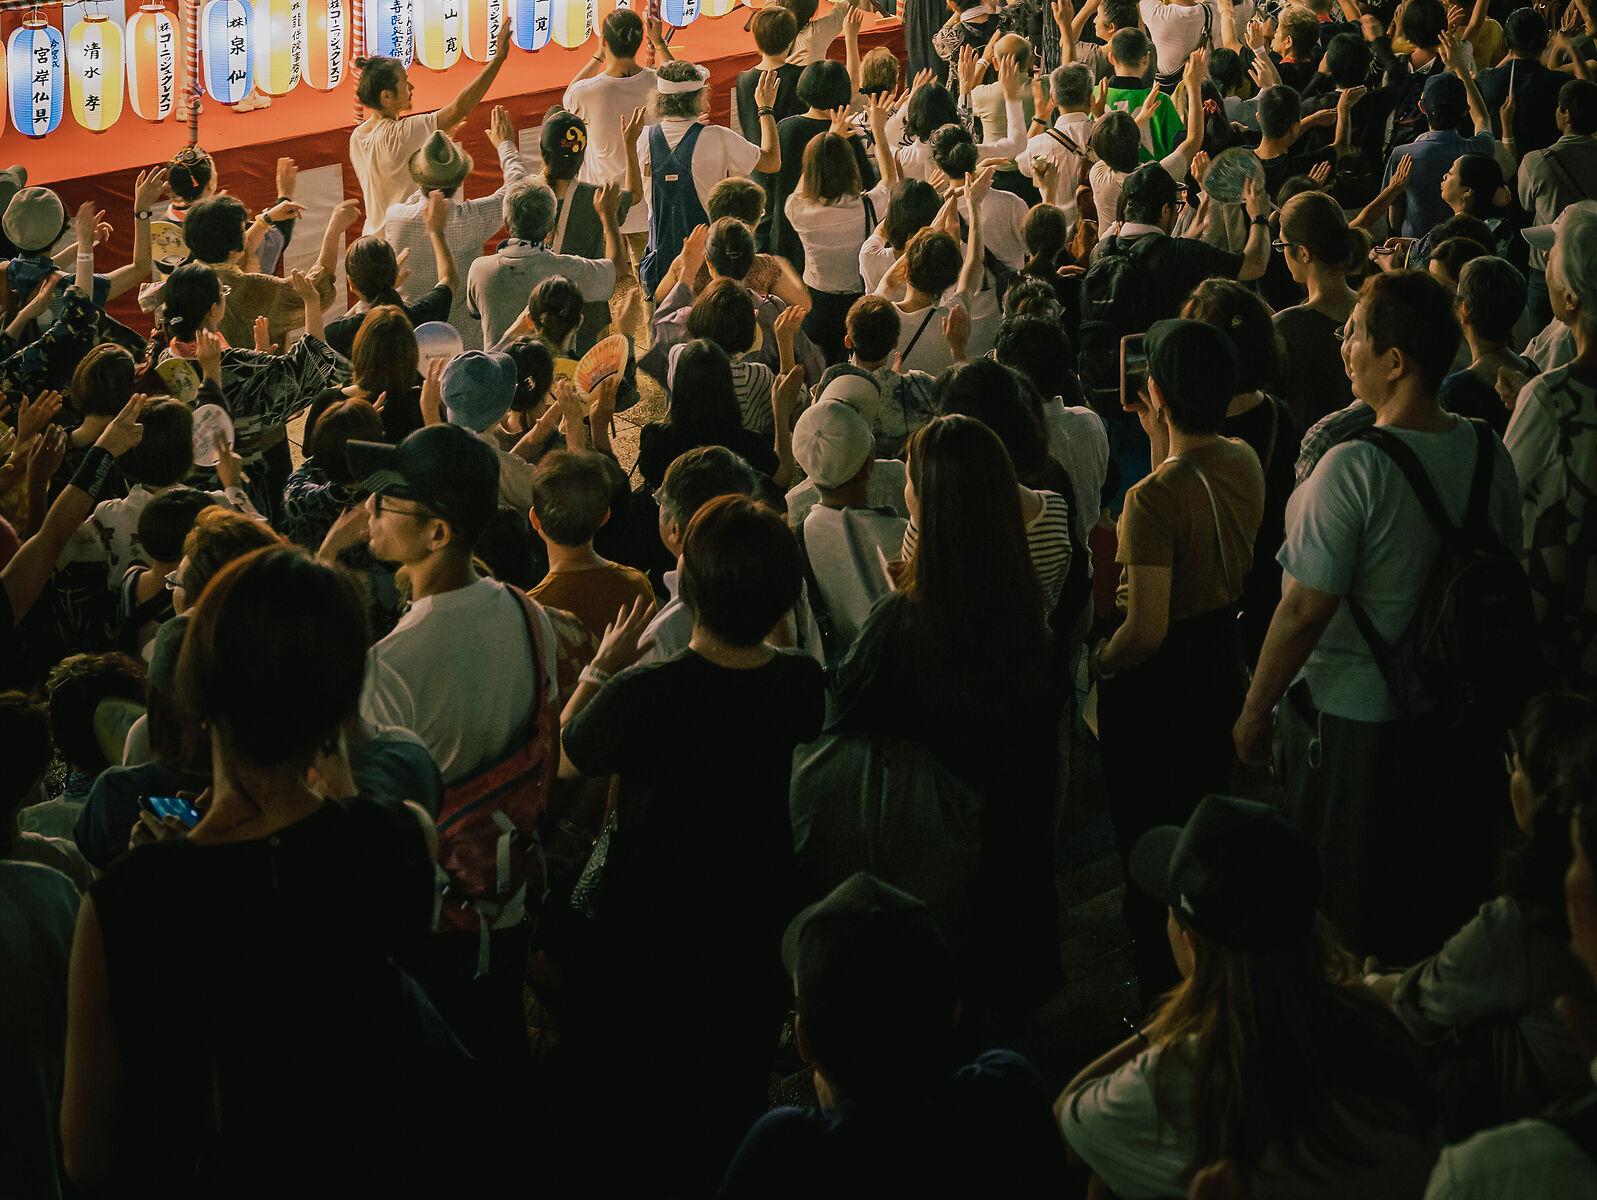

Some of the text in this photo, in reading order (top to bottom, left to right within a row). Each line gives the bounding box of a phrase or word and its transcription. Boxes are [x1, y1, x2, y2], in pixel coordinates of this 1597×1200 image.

[31, 47, 51, 124] 宮岸仏具
[84, 42, 101, 112] 清水孝
